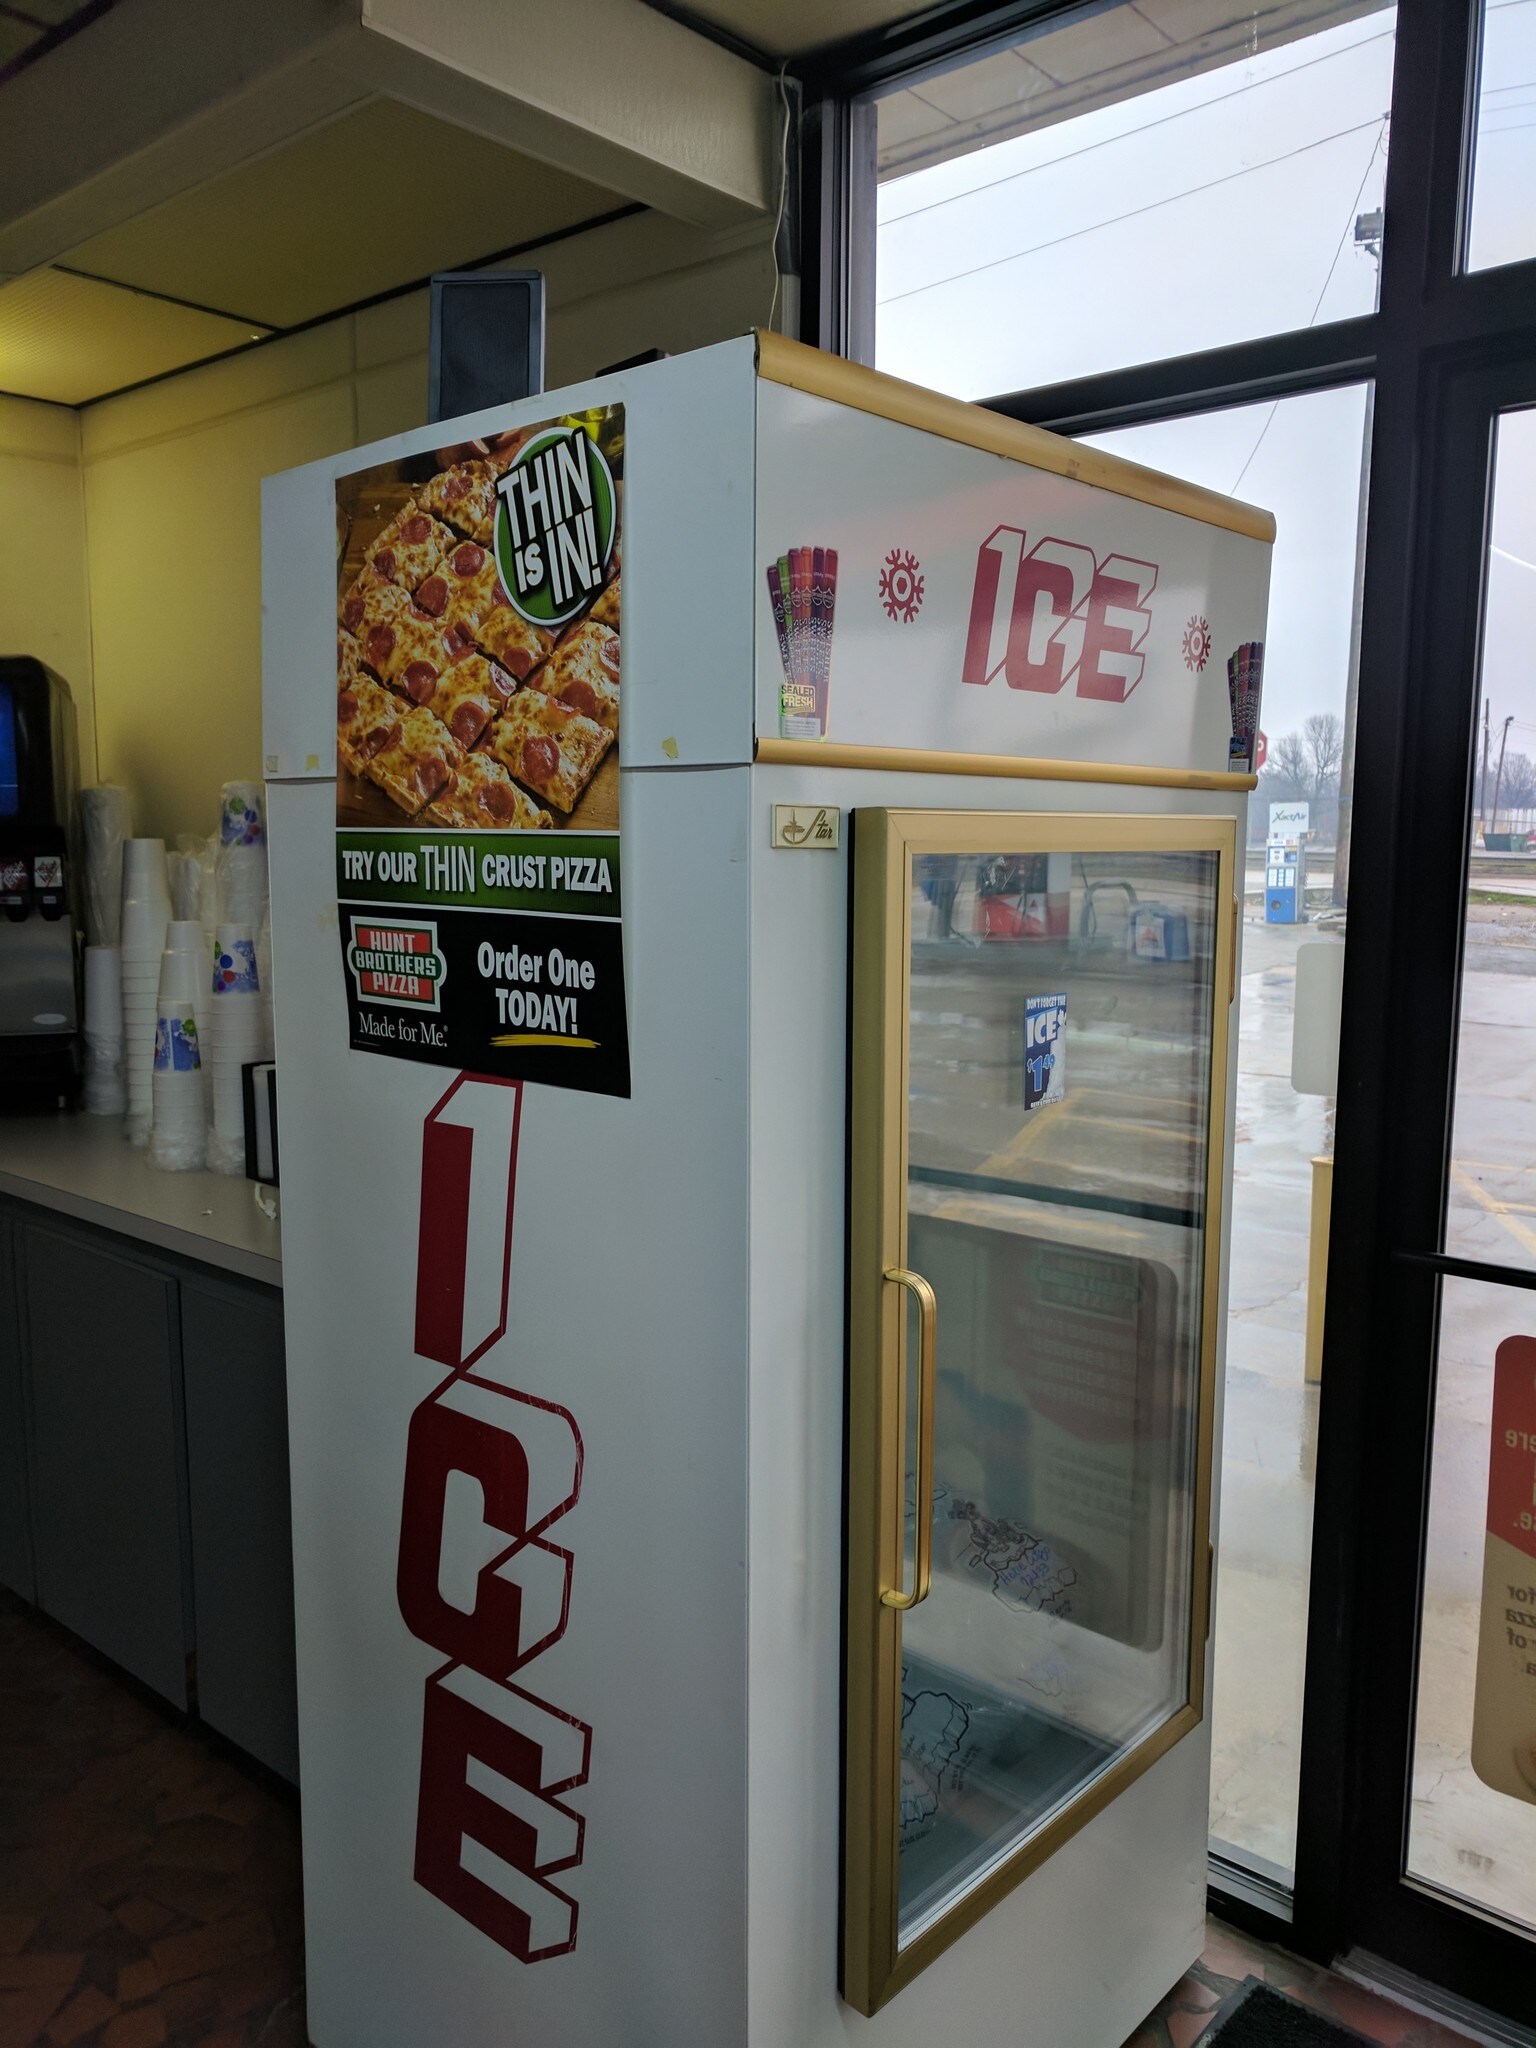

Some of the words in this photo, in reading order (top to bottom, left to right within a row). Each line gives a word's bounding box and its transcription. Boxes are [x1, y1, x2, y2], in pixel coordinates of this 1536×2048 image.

[497, 431, 593, 548] THIN
[515, 542, 544, 594] IS
[546, 508, 602, 606] IN!
[962, 525, 1159, 703] ICE
[782, 685, 815, 697] SEALED
[782, 695, 814, 708] FRESH
[783, 809, 833, 845] Star
[343, 850, 375, 881] TRY
[378, 851, 418, 883] OUR
[420, 845, 475, 893] THIN
[482, 853, 547, 889] CRUST
[551, 856, 613, 893] PIZZA
[369, 930, 415, 954] HUNT
[355, 950, 437, 977] BROTHERS
[477, 941, 543, 984] Order
[548, 948, 596, 990] One
[372, 971, 420, 996] PIZZA
[359, 1011, 396, 1039] Made
[398, 1017, 418, 1042] for
[495, 987, 578, 1035] TODAY!
[1026, 1009, 1057, 1048] ICE
[397, 1069, 593, 1966] ICE
